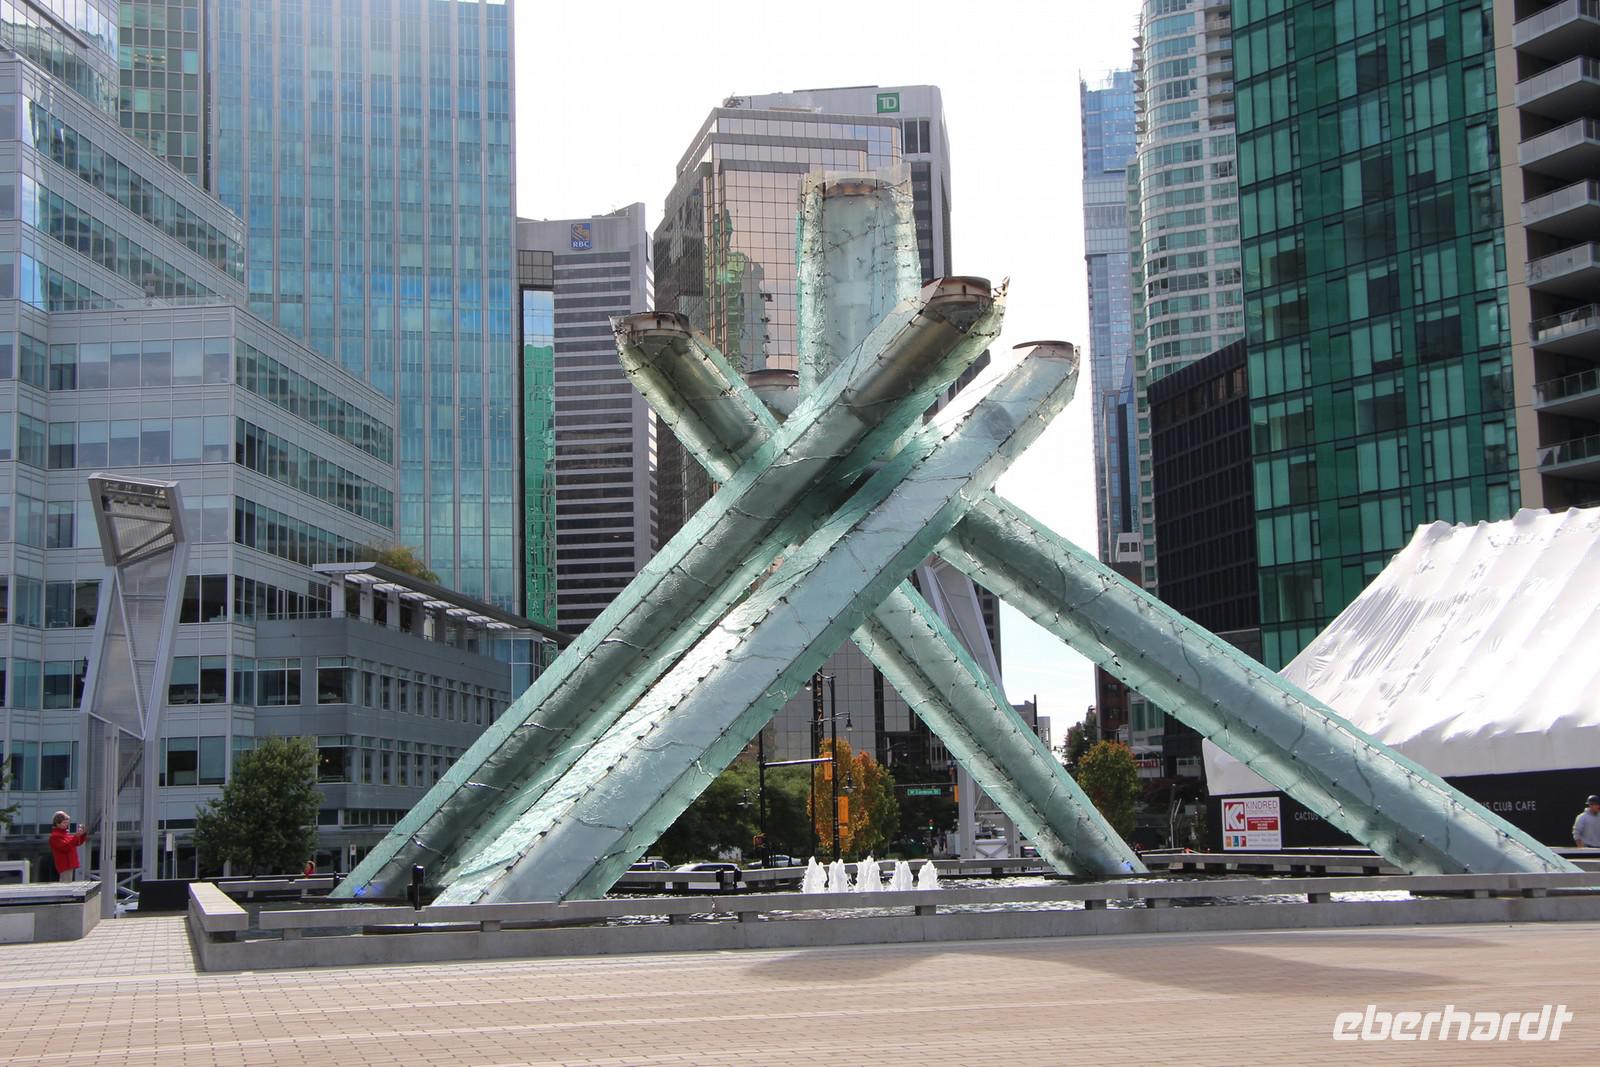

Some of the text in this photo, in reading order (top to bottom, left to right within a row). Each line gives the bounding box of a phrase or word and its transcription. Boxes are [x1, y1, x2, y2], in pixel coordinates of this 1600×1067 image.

[880, 97, 896, 109] TD
[1246, 800, 1278, 809] KINDRED
[1493, 802, 1512, 811] CLUB
